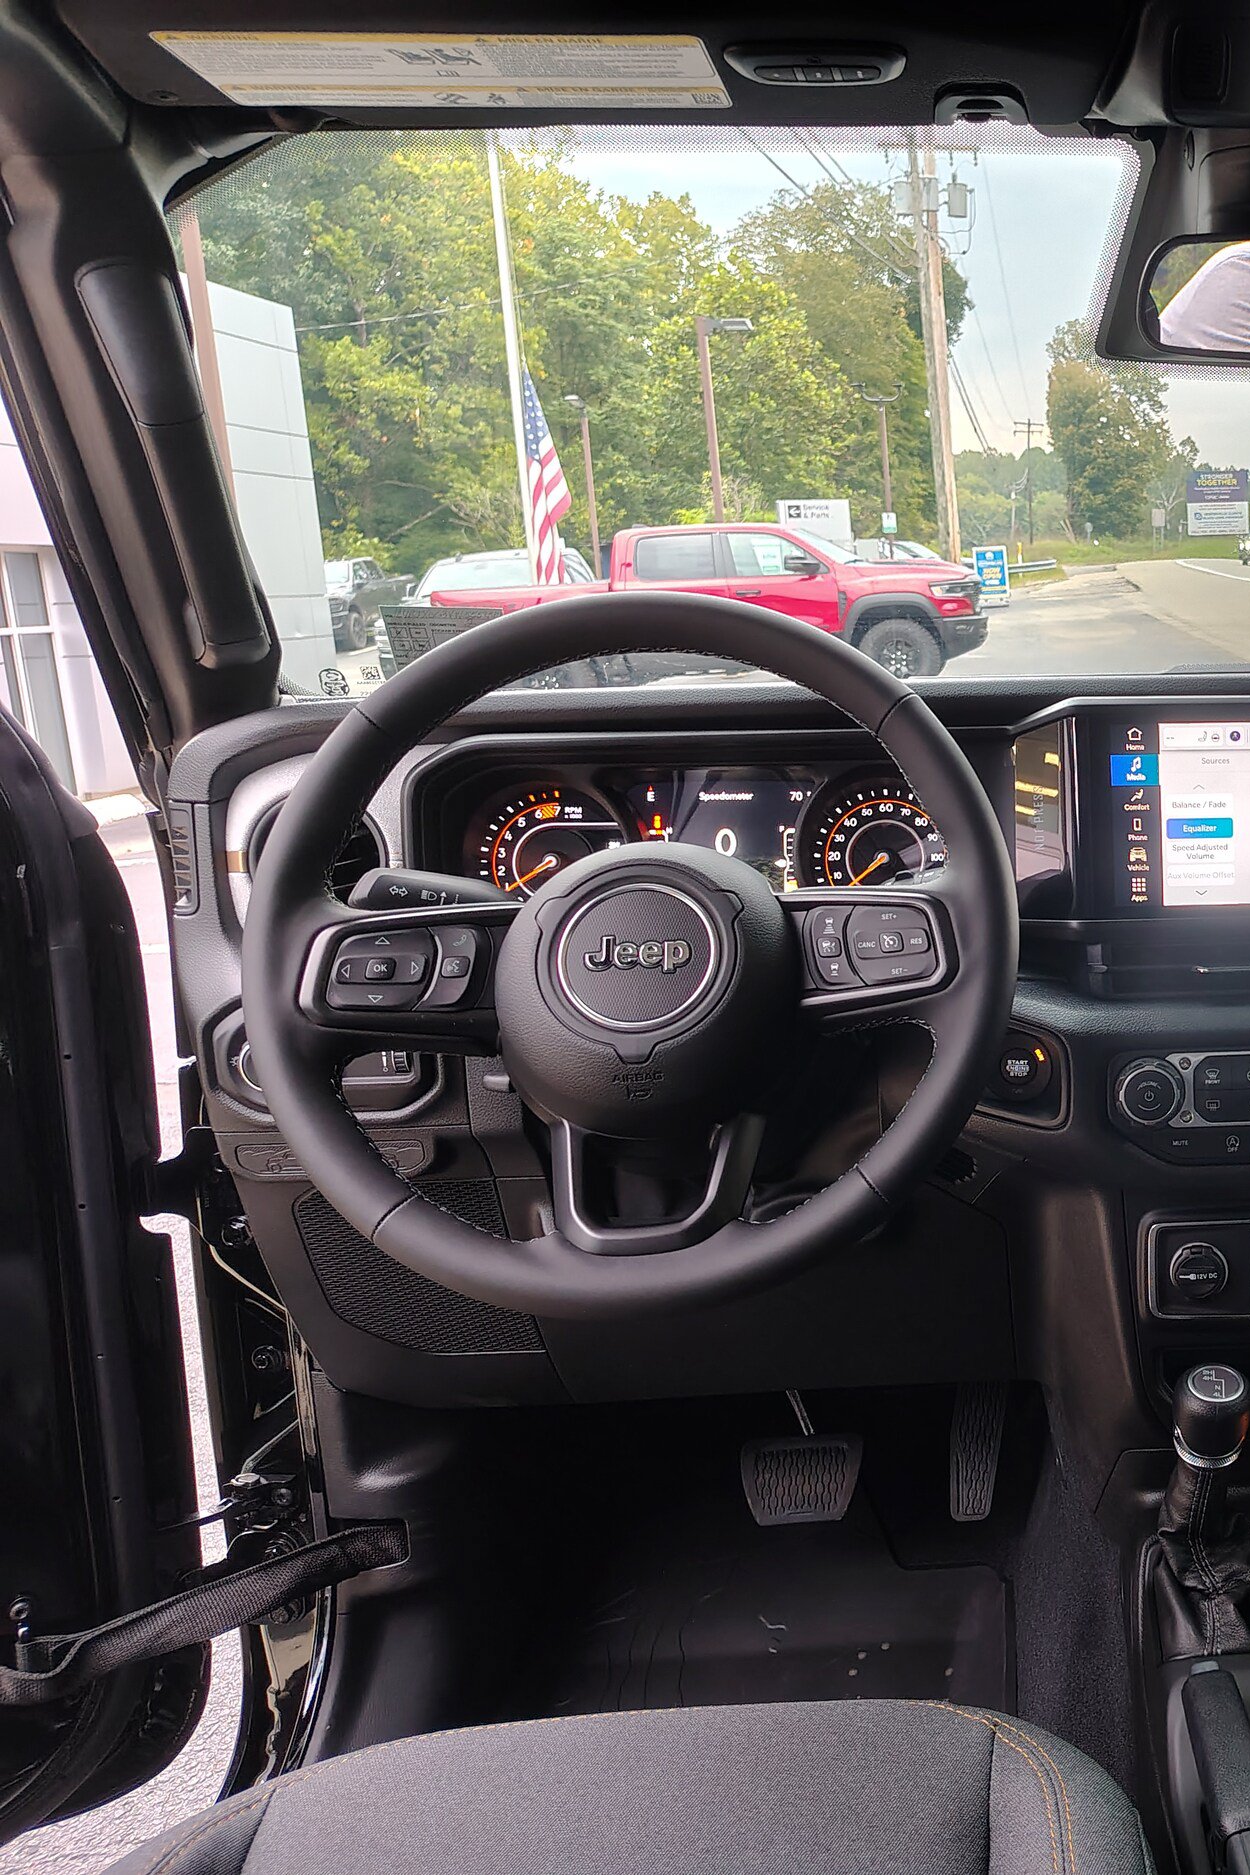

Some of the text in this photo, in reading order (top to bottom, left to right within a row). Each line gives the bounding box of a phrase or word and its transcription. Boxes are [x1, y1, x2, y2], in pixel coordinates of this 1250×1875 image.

[1125, 743, 1145, 751] Home
[1201, 757, 1230, 765] Sources
[646, 791, 655, 802] E
[698, 791, 754, 802] Speedometer
[789, 791, 803, 801] 70
[879, 803, 894, 812] 60
[1123, 803, 1150, 811] Comfort
[1172, 801, 1201, 809] Balance
[1208, 800, 1227, 808] Fade
[535, 809, 543, 819] 6
[553, 806, 561, 816] 7
[564, 806, 583, 814] RPM
[900, 808, 911, 816] 70
[518, 817, 526, 827] 5
[843, 818, 857, 827] 40
[915, 817, 928, 826] 80
[1182, 824, 1217, 833] Equalizer
[504, 831, 513, 841] 4
[834, 834, 845, 842] 30
[927, 833, 938, 842] 90
[715, 827, 738, 857] 0
[1172, 843, 1228, 852] Speed Adjusted
[498, 848, 506, 858] 3
[828, 852, 841, 861] 20
[931, 853, 944, 862] 100
[497, 866, 506, 876] 2
[834, 871, 842, 880] 10
[1211, 871, 1235, 879] Offset
[1131, 894, 1148, 902] Apps
[584, 934, 692, 974] Jeep
[373, 964, 388, 972] OK
[612, 1072, 665, 1084] AIRBAG
